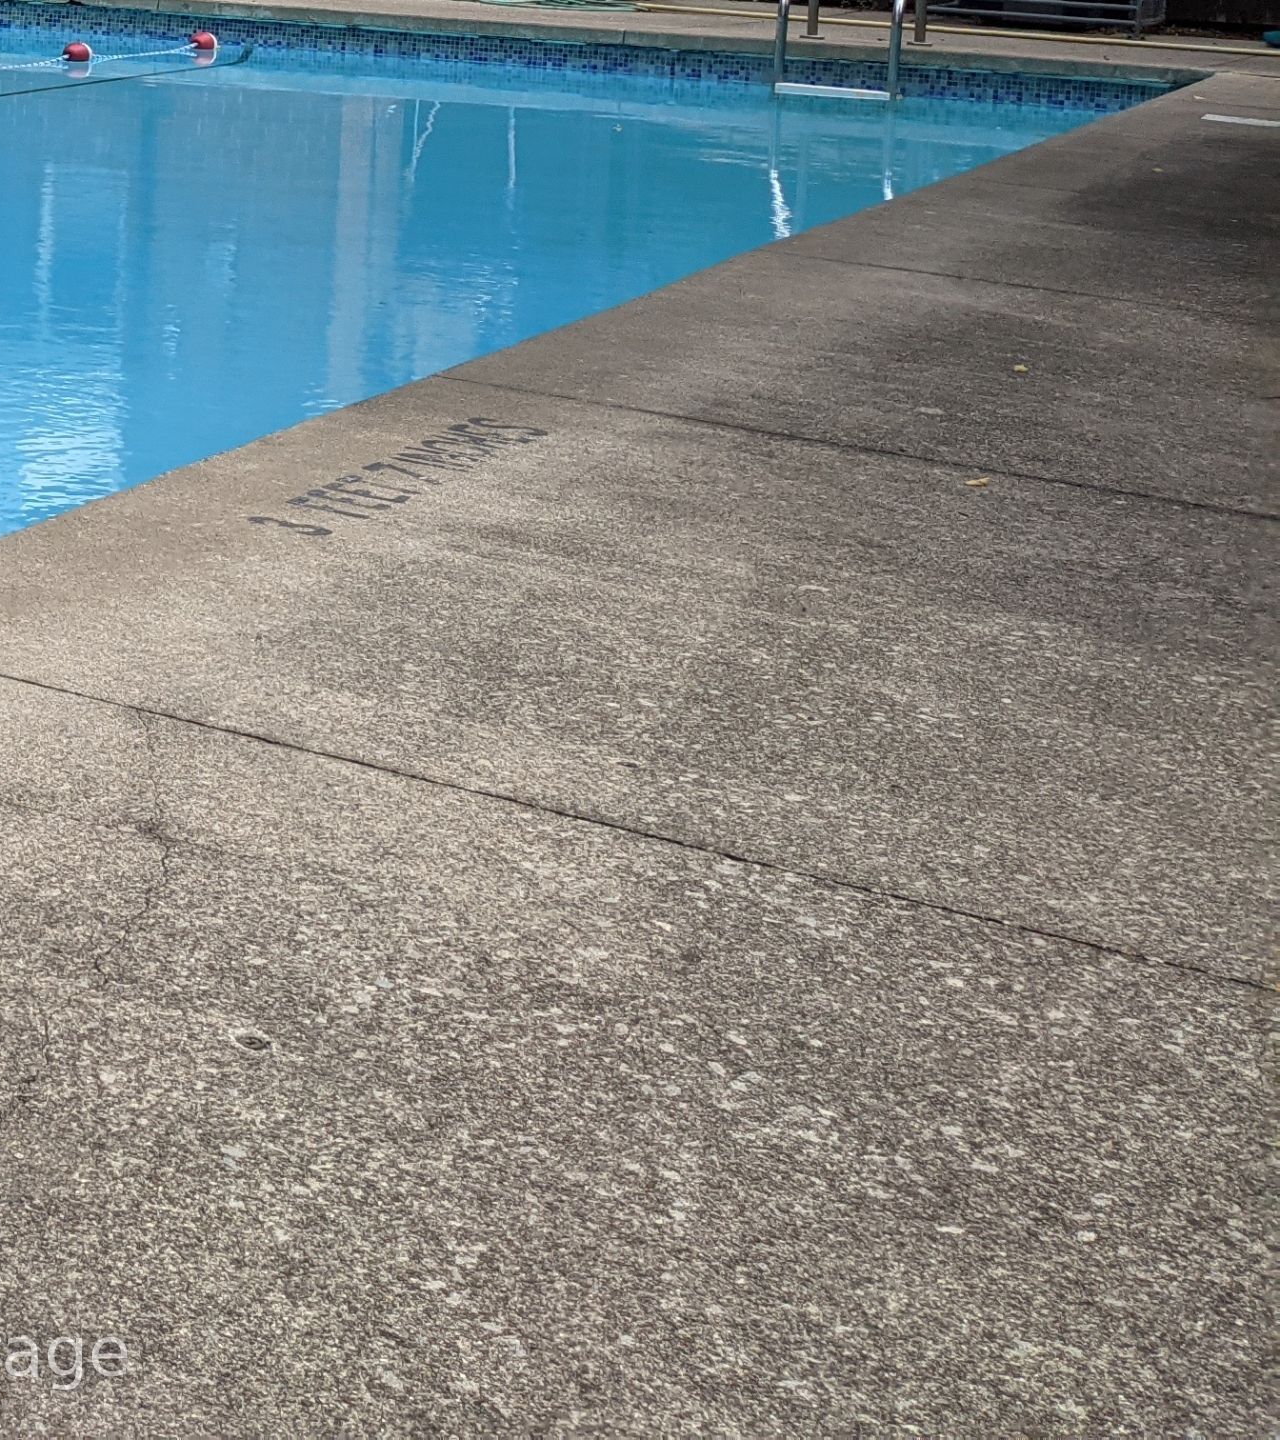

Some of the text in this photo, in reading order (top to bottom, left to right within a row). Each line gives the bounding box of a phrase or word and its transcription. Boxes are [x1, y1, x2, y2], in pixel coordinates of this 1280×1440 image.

[390, 416, 549, 473] INCHES
[286, 474, 421, 520] FEET
[362, 462, 443, 486] 7
